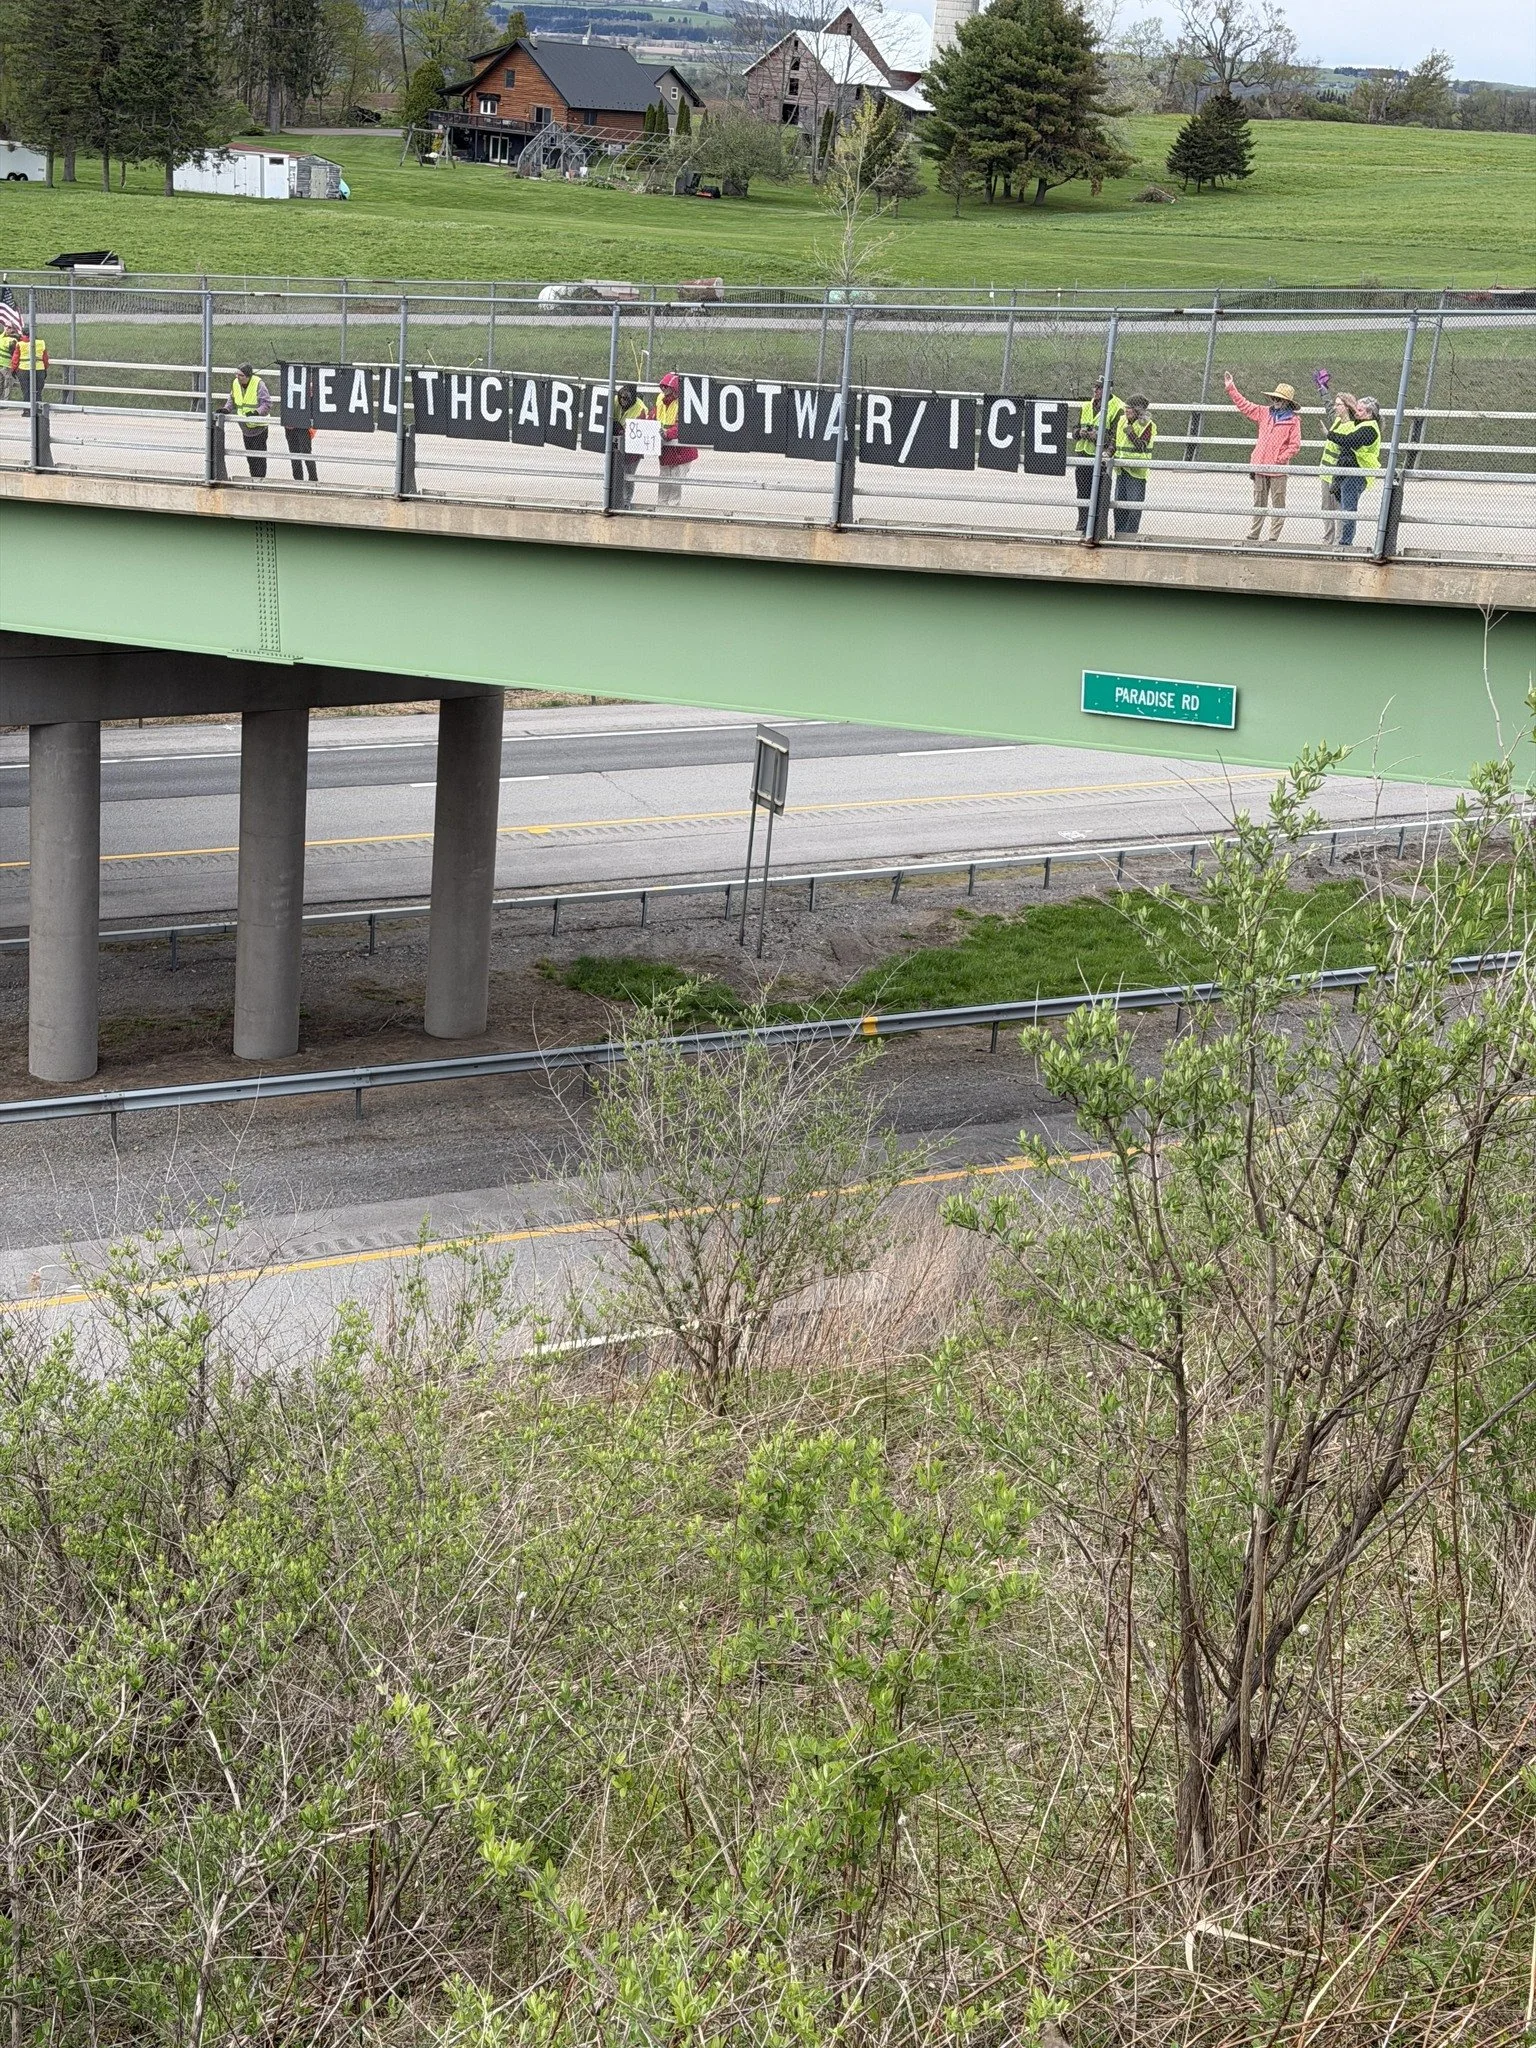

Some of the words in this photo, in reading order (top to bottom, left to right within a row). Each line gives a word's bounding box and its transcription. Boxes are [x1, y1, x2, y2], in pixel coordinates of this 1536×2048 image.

[287, 366, 606, 433] HEALTHCARE
[629, 421, 643, 440] 86
[1115, 687, 1175, 708] PARADISE
[1181, 694, 1200, 711] RD
